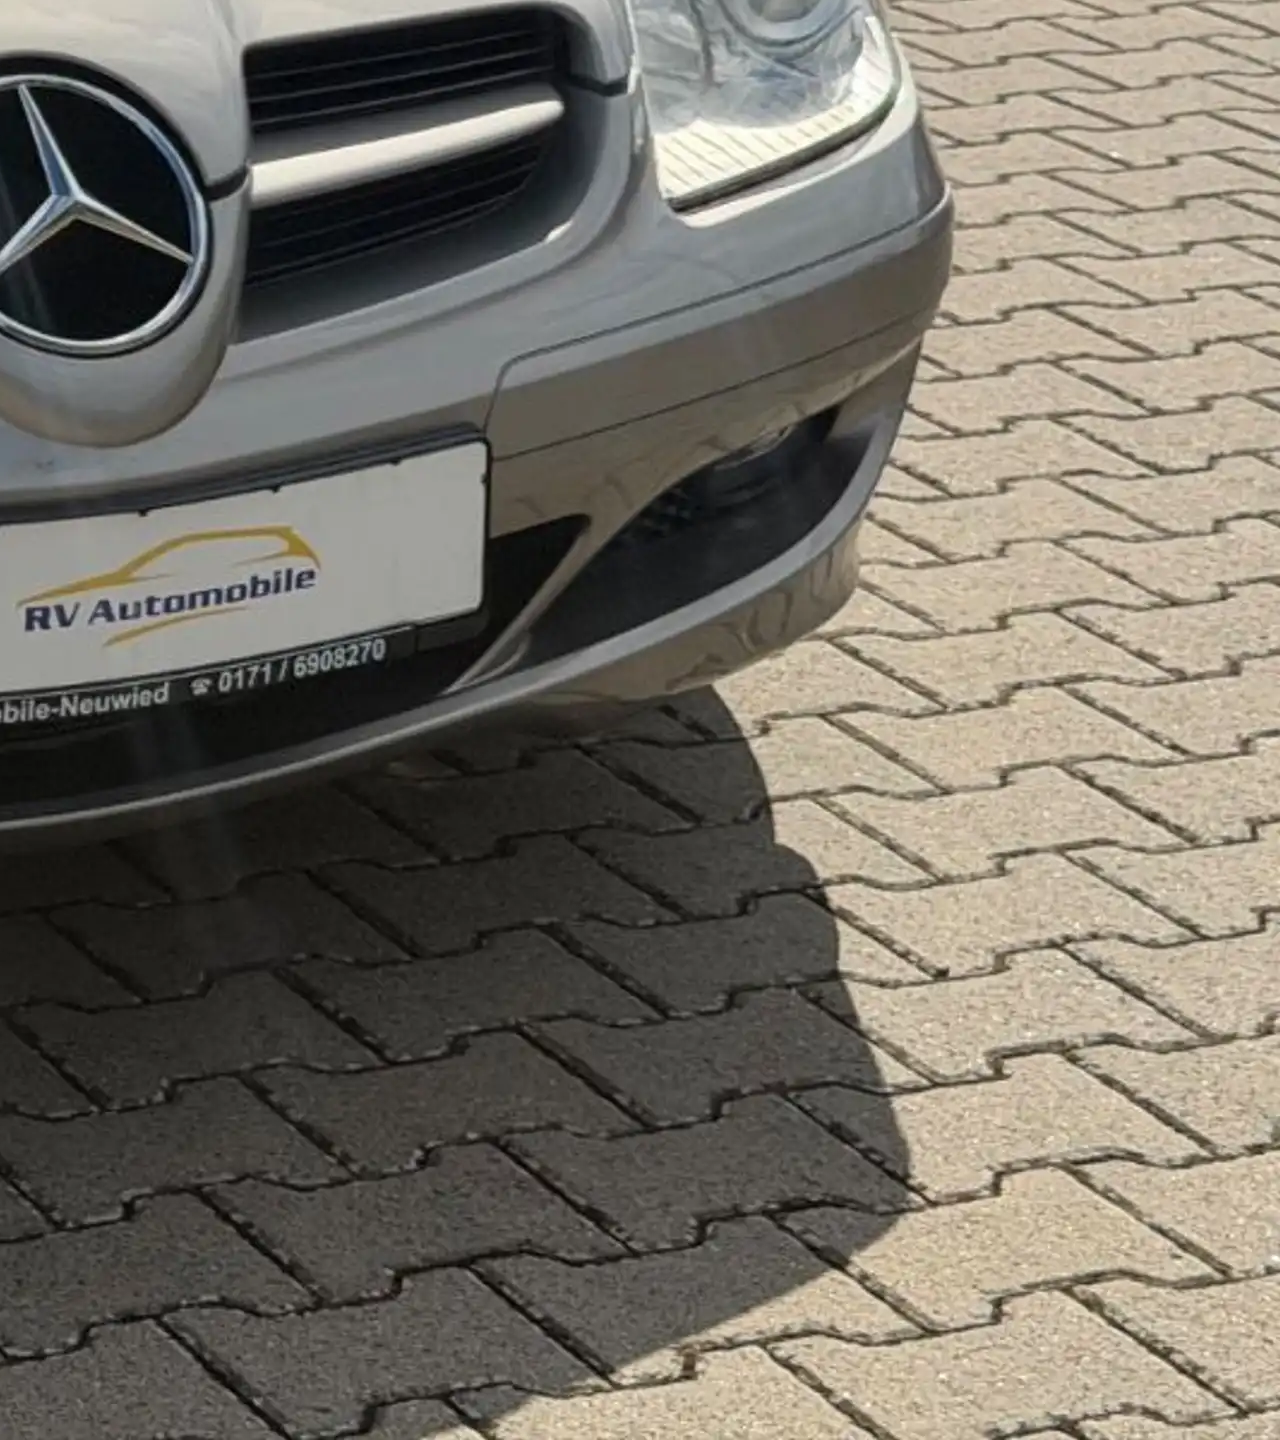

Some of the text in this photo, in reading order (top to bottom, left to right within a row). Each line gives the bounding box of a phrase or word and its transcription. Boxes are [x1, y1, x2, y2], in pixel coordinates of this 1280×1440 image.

[24, 568, 316, 632] RV Automobile
[218, 663, 271, 692] 0171
[293, 638, 386, 678] 6908270
